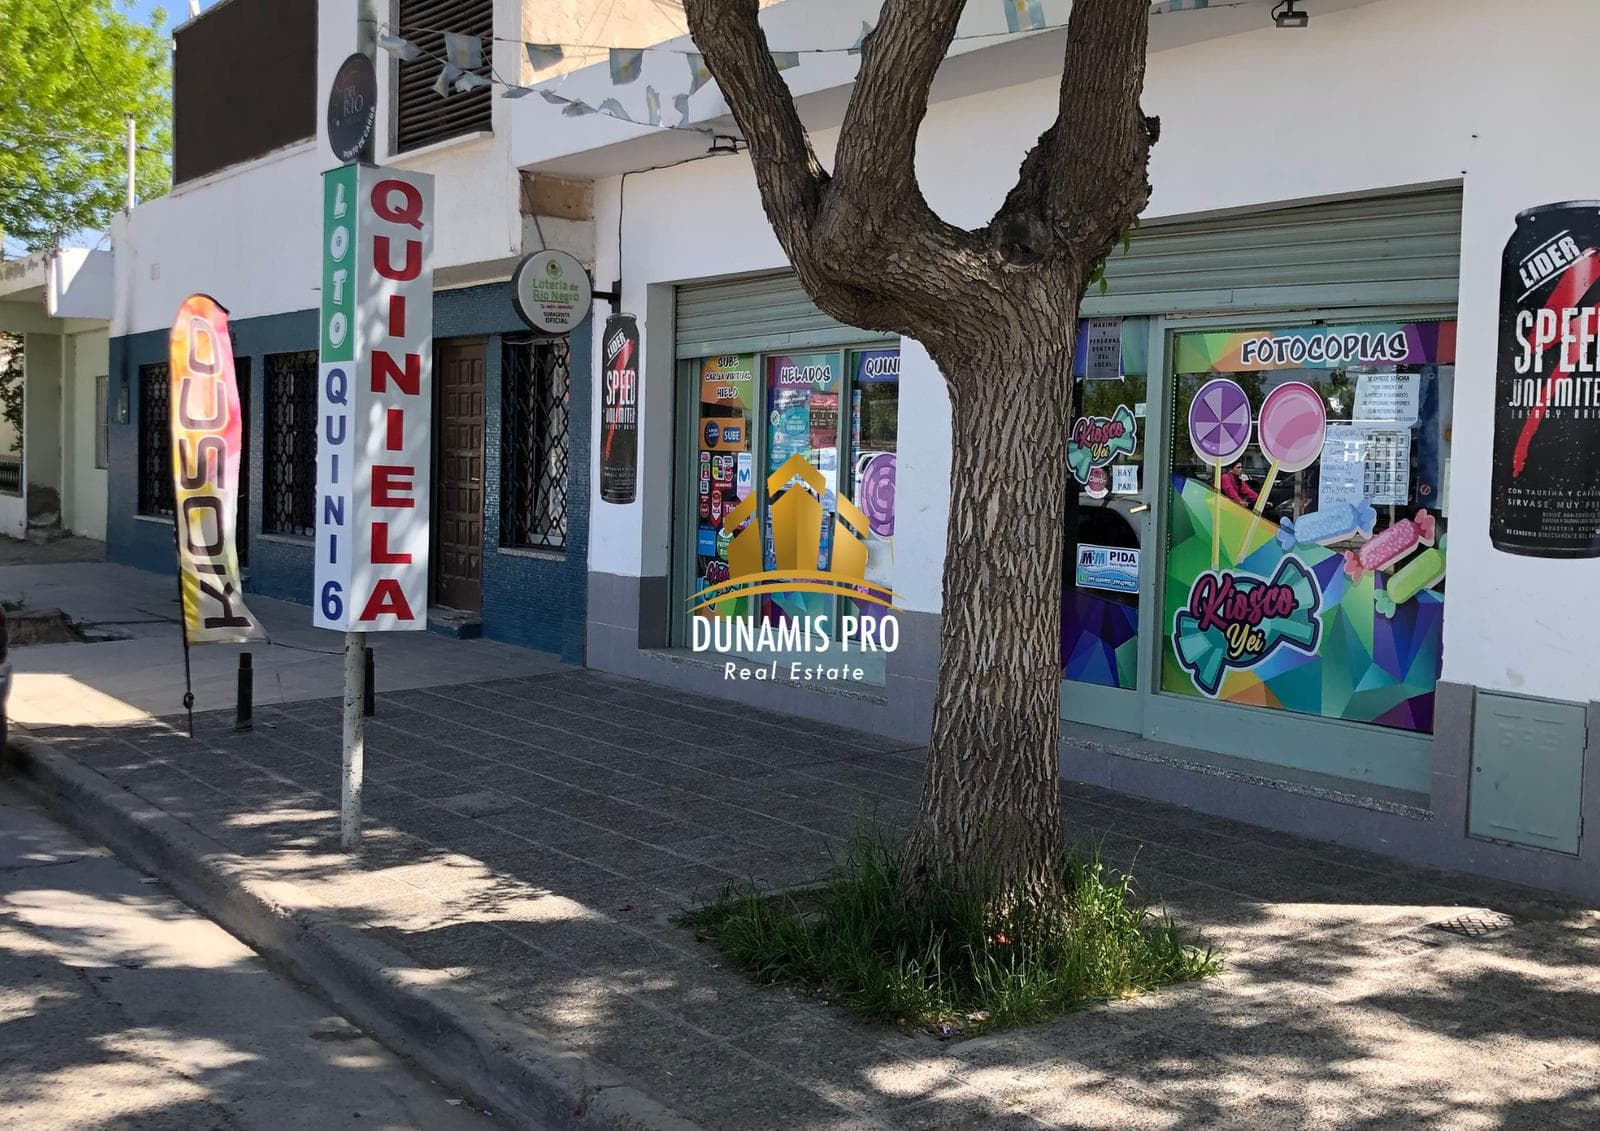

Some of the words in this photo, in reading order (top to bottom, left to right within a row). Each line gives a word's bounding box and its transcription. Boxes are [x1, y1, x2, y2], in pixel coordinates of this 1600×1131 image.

[329, 182, 350, 349] LOTO
[1518, 234, 1581, 290] LIDER
[550, 290, 580, 304] Negro
[544, 317, 569, 325] OFICIAL
[607, 331, 627, 359] LIDER
[1242, 332, 1408, 365] FOTOCOPIAS
[1514, 306, 1600, 375] SPEE
[717, 355, 739, 369] SUBE
[780, 364, 832, 384] HELADOS
[359, 179, 425, 621] QUINIELA
[606, 369, 636, 406] SPEED
[716, 386, 739, 399] HIELO
[724, 430, 740, 441] SUBE
[1073, 417, 1126, 449] Kiosco
[324, 368, 348, 564] QUINI
[1091, 443, 1111, 462] Yei
[179, 316, 252, 629] KIOSCO
[1117, 468, 1132, 477] HAY
[1117, 483, 1132, 491] PAN
[1507, 487, 1522, 495] CON
[1526, 489, 1563, 497] TAURINA
[1556, 501, 1580, 509] MUY
[1109, 551, 1136, 564] PIDA
[321, 580, 344, 621] 6
[1190, 572, 1299, 631] Kiosco
[1225, 622, 1266, 660] Yei
